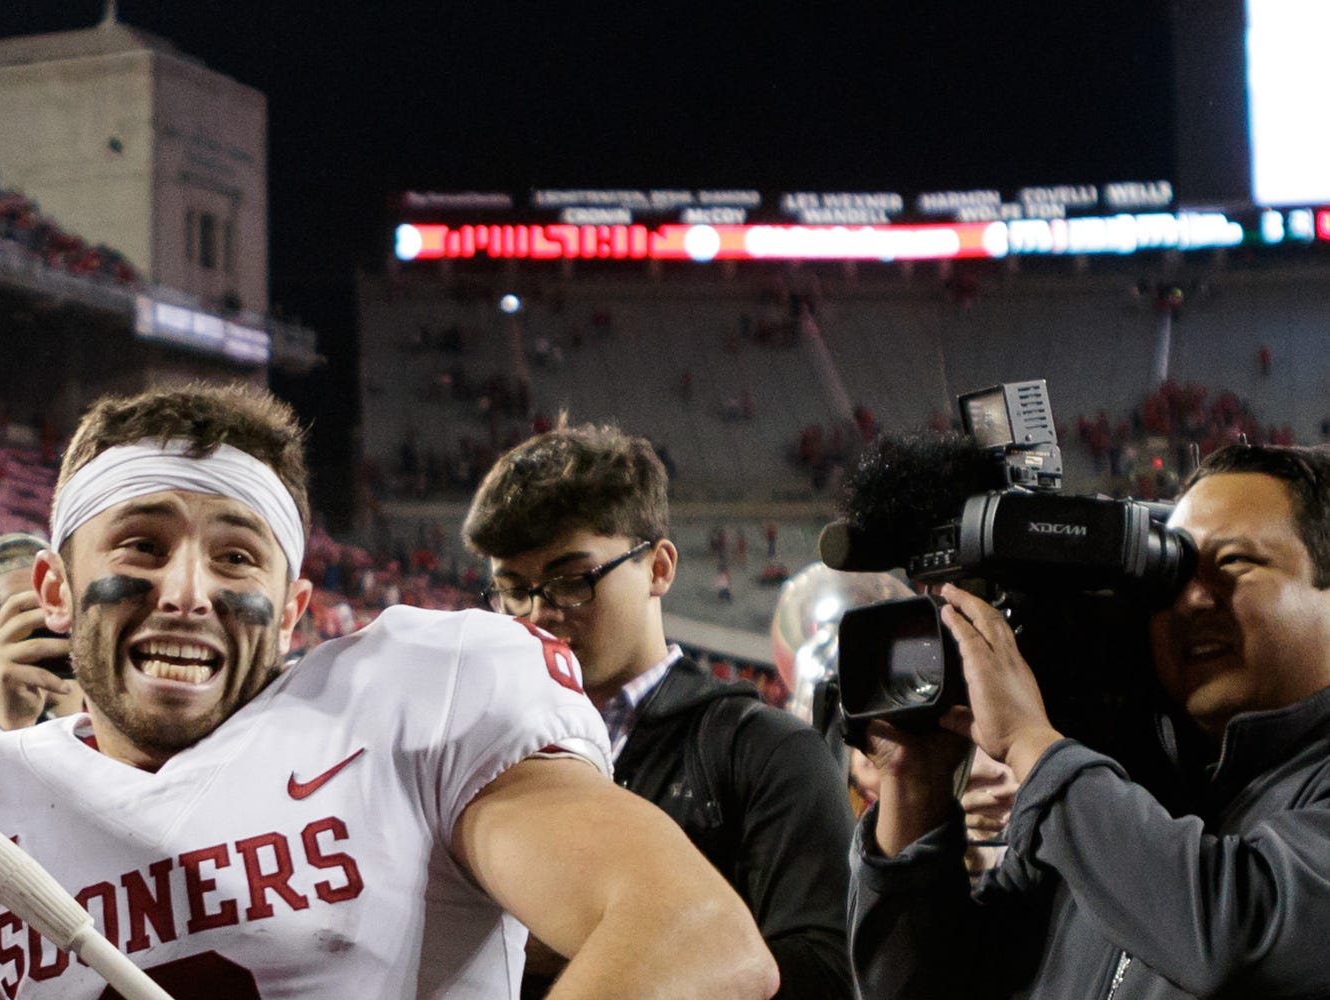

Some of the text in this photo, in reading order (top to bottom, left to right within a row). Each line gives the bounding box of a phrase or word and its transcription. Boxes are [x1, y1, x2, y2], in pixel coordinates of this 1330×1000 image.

[784, 193, 903, 211] LES WEXNER
[919, 191, 1001, 210] HARMON
[1107, 181, 1171, 205] WELLS
[802, 208, 890, 224] WANDELL
[957, 203, 1022, 222] WOLFE
[1030, 522, 1087, 536] XDCAM
